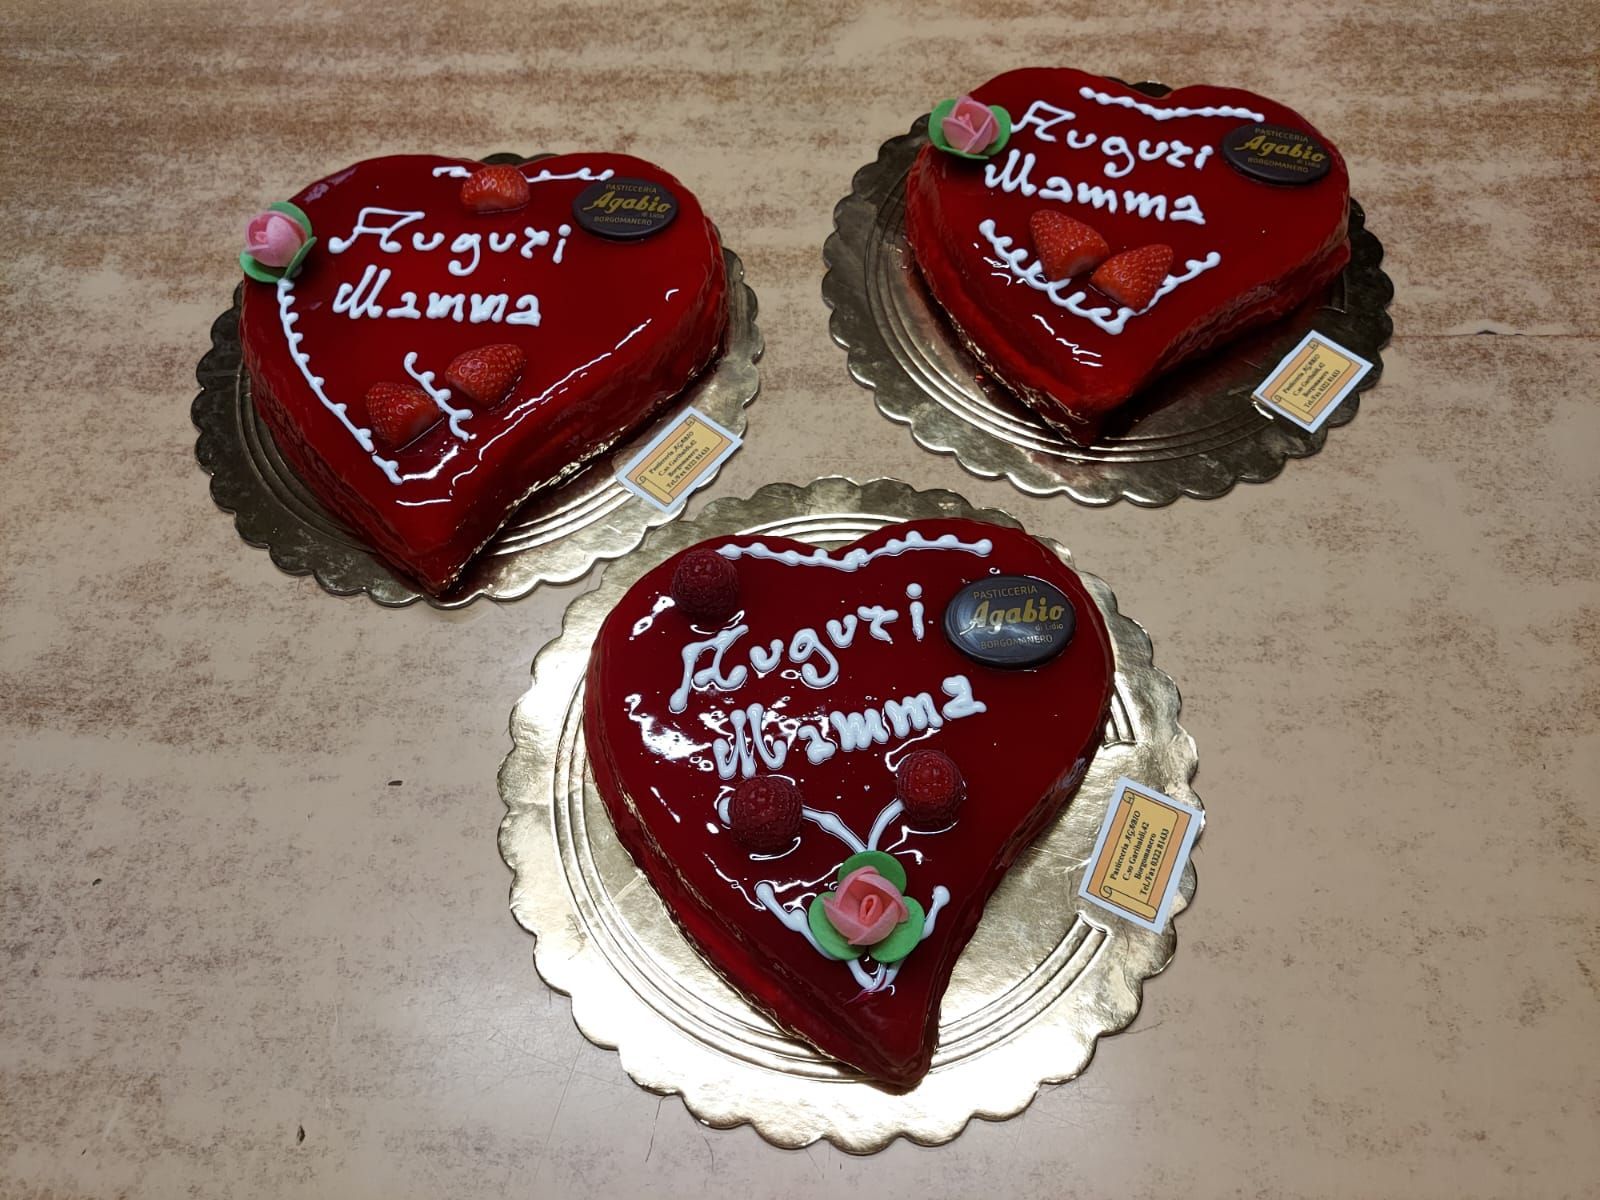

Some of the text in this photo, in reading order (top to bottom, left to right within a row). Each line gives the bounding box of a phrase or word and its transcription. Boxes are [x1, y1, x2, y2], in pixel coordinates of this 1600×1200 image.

[1009, 100, 1214, 179] Auguri
[1233, 135, 1326, 162] Agabio
[582, 190, 672, 214] Agabio
[605, 183, 657, 194] PASTICCERIA
[984, 149, 1206, 225] Mamma
[593, 215, 653, 226] BORGOMANERO
[328, 206, 571, 276] Auguri
[332, 264, 541, 327] Mamma
[973, 585, 1038, 599] PASTICCERIA
[959, 597, 1065, 636] Agabio
[669, 583, 925, 713] Auguri
[981, 634, 1053, 649] BORGOMANERO
[713, 675, 988, 779] Mamma
[1110, 843, 1129, 880] Pasticceria
[1134, 833, 1156, 880] Borgomanero
[1151, 849, 1162, 867] 0322
[1157, 828, 1170, 850] 81433
